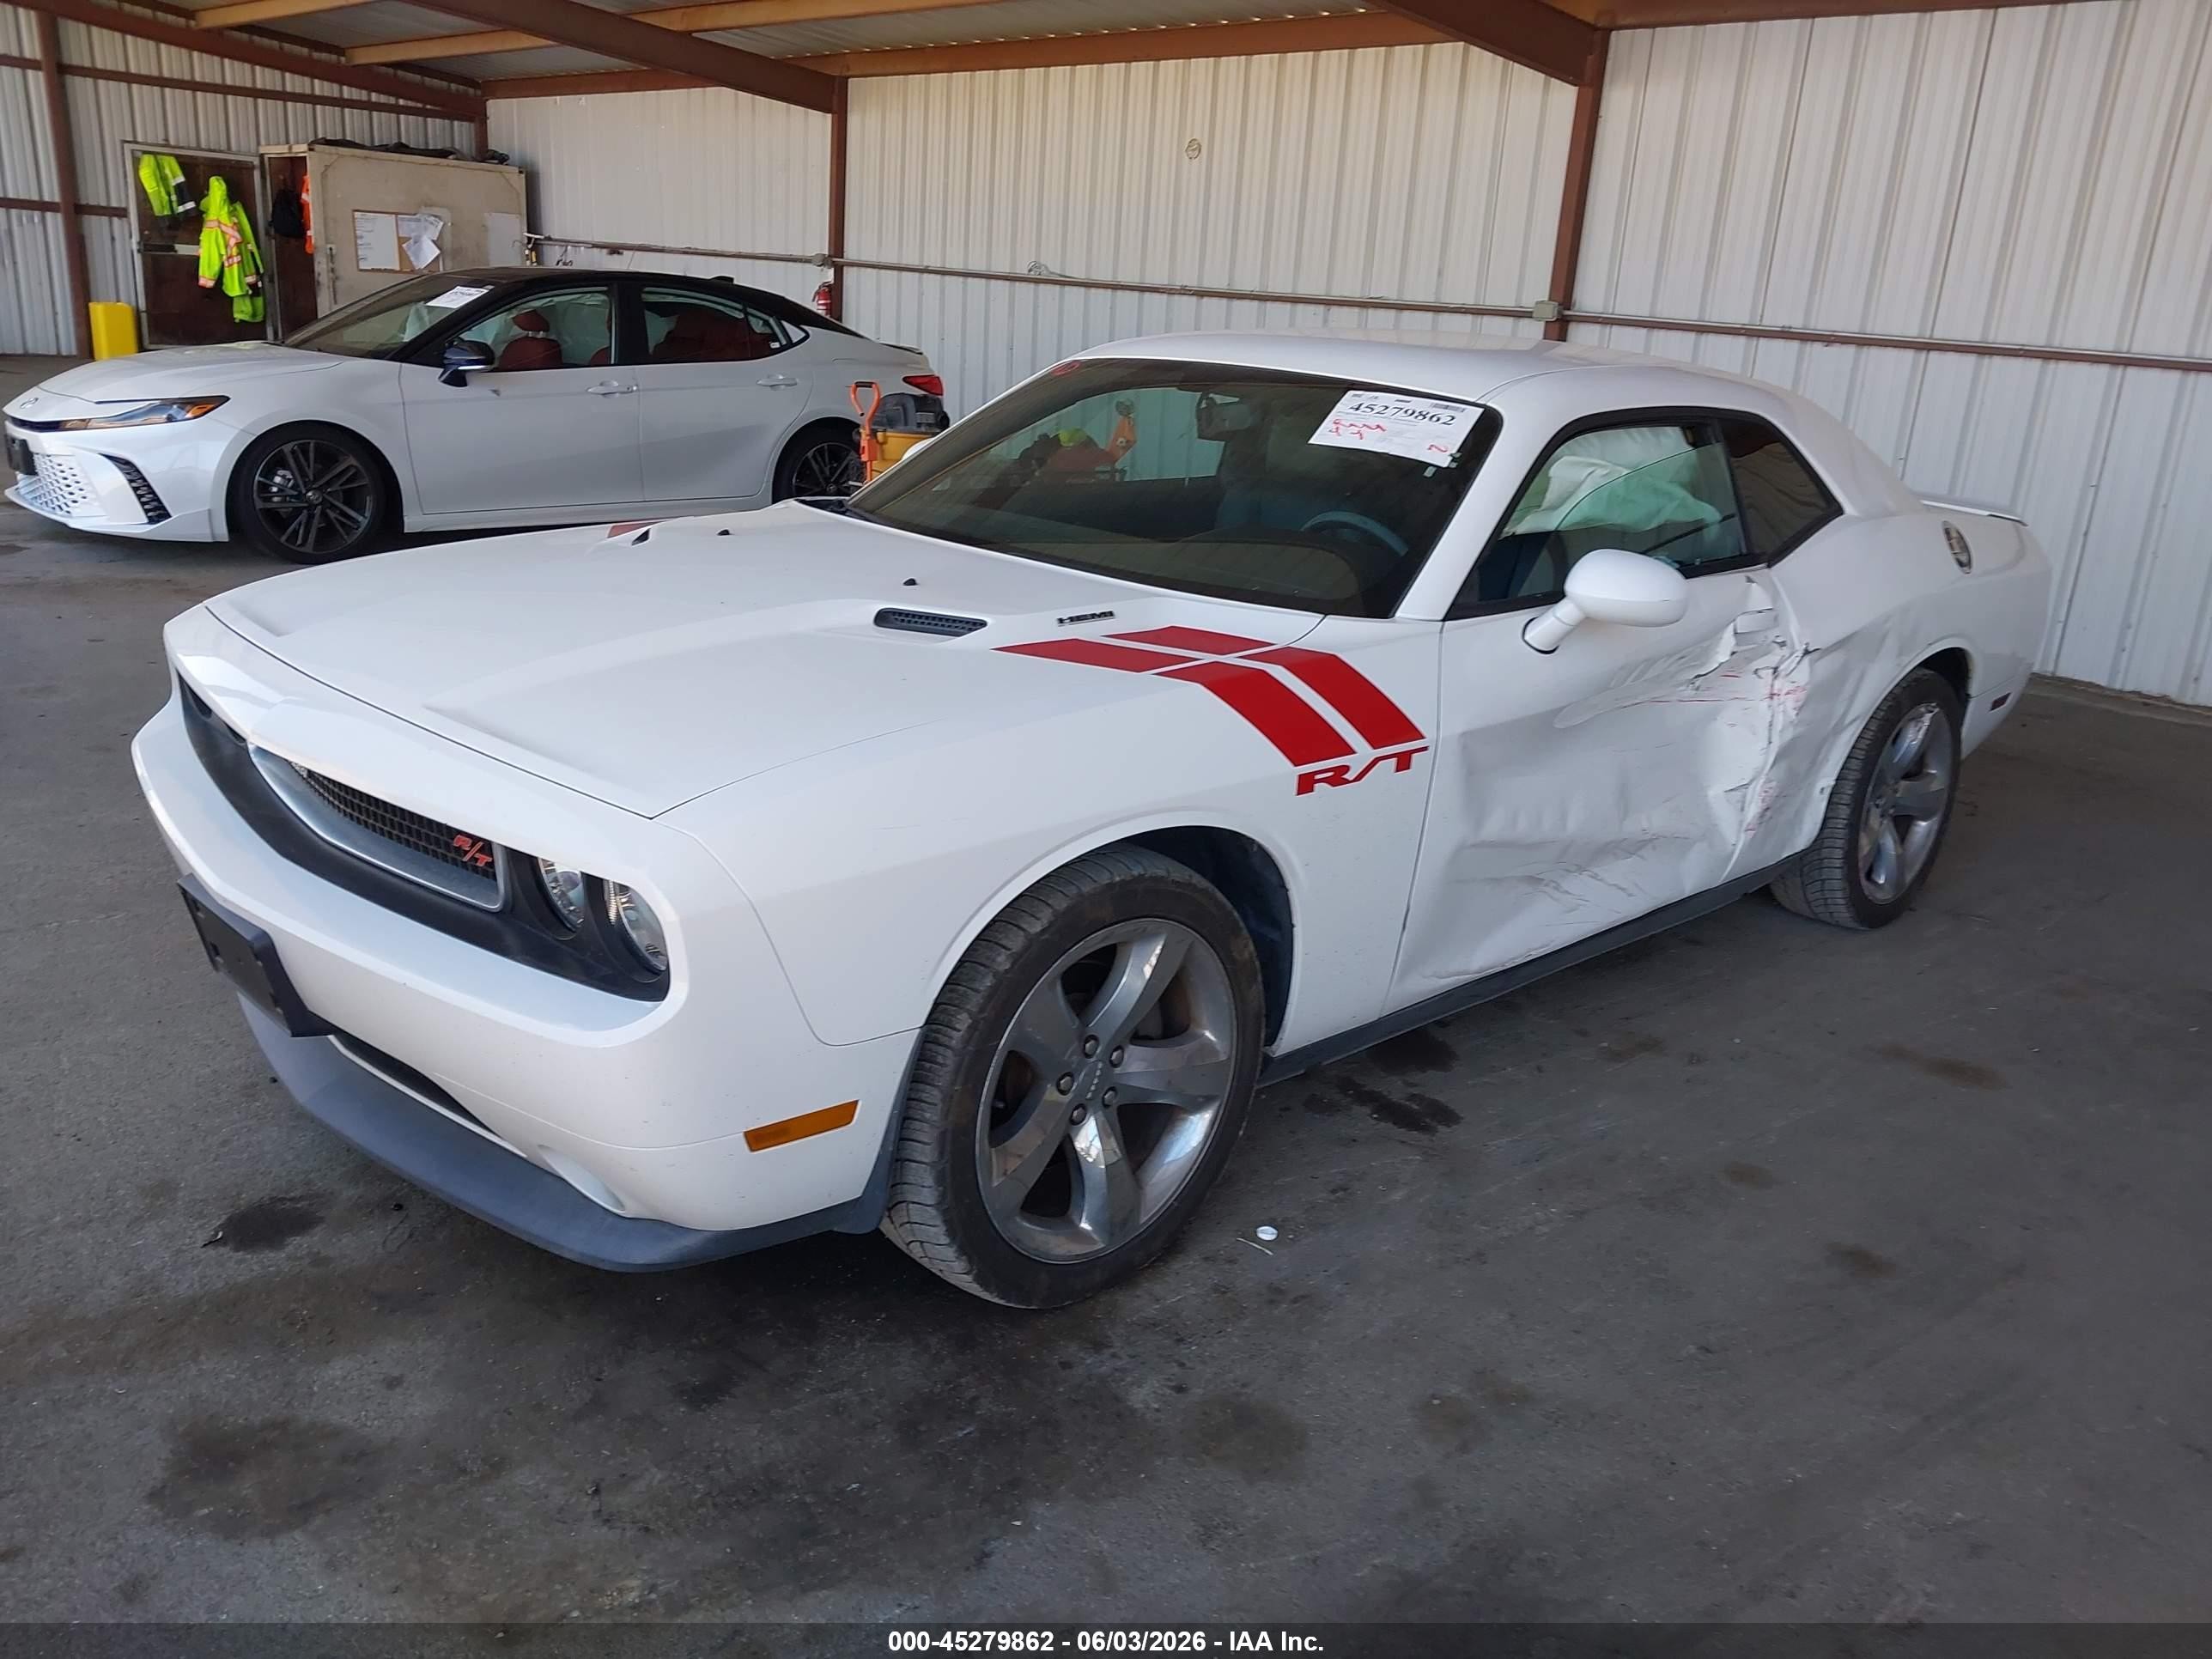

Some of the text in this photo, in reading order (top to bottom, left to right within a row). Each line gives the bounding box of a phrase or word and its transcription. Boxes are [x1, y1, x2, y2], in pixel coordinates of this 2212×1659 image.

[1349, 403, 1455, 425] 45279862
[1296, 746, 1430, 796] R/T
[453, 835, 492, 866] R/T
